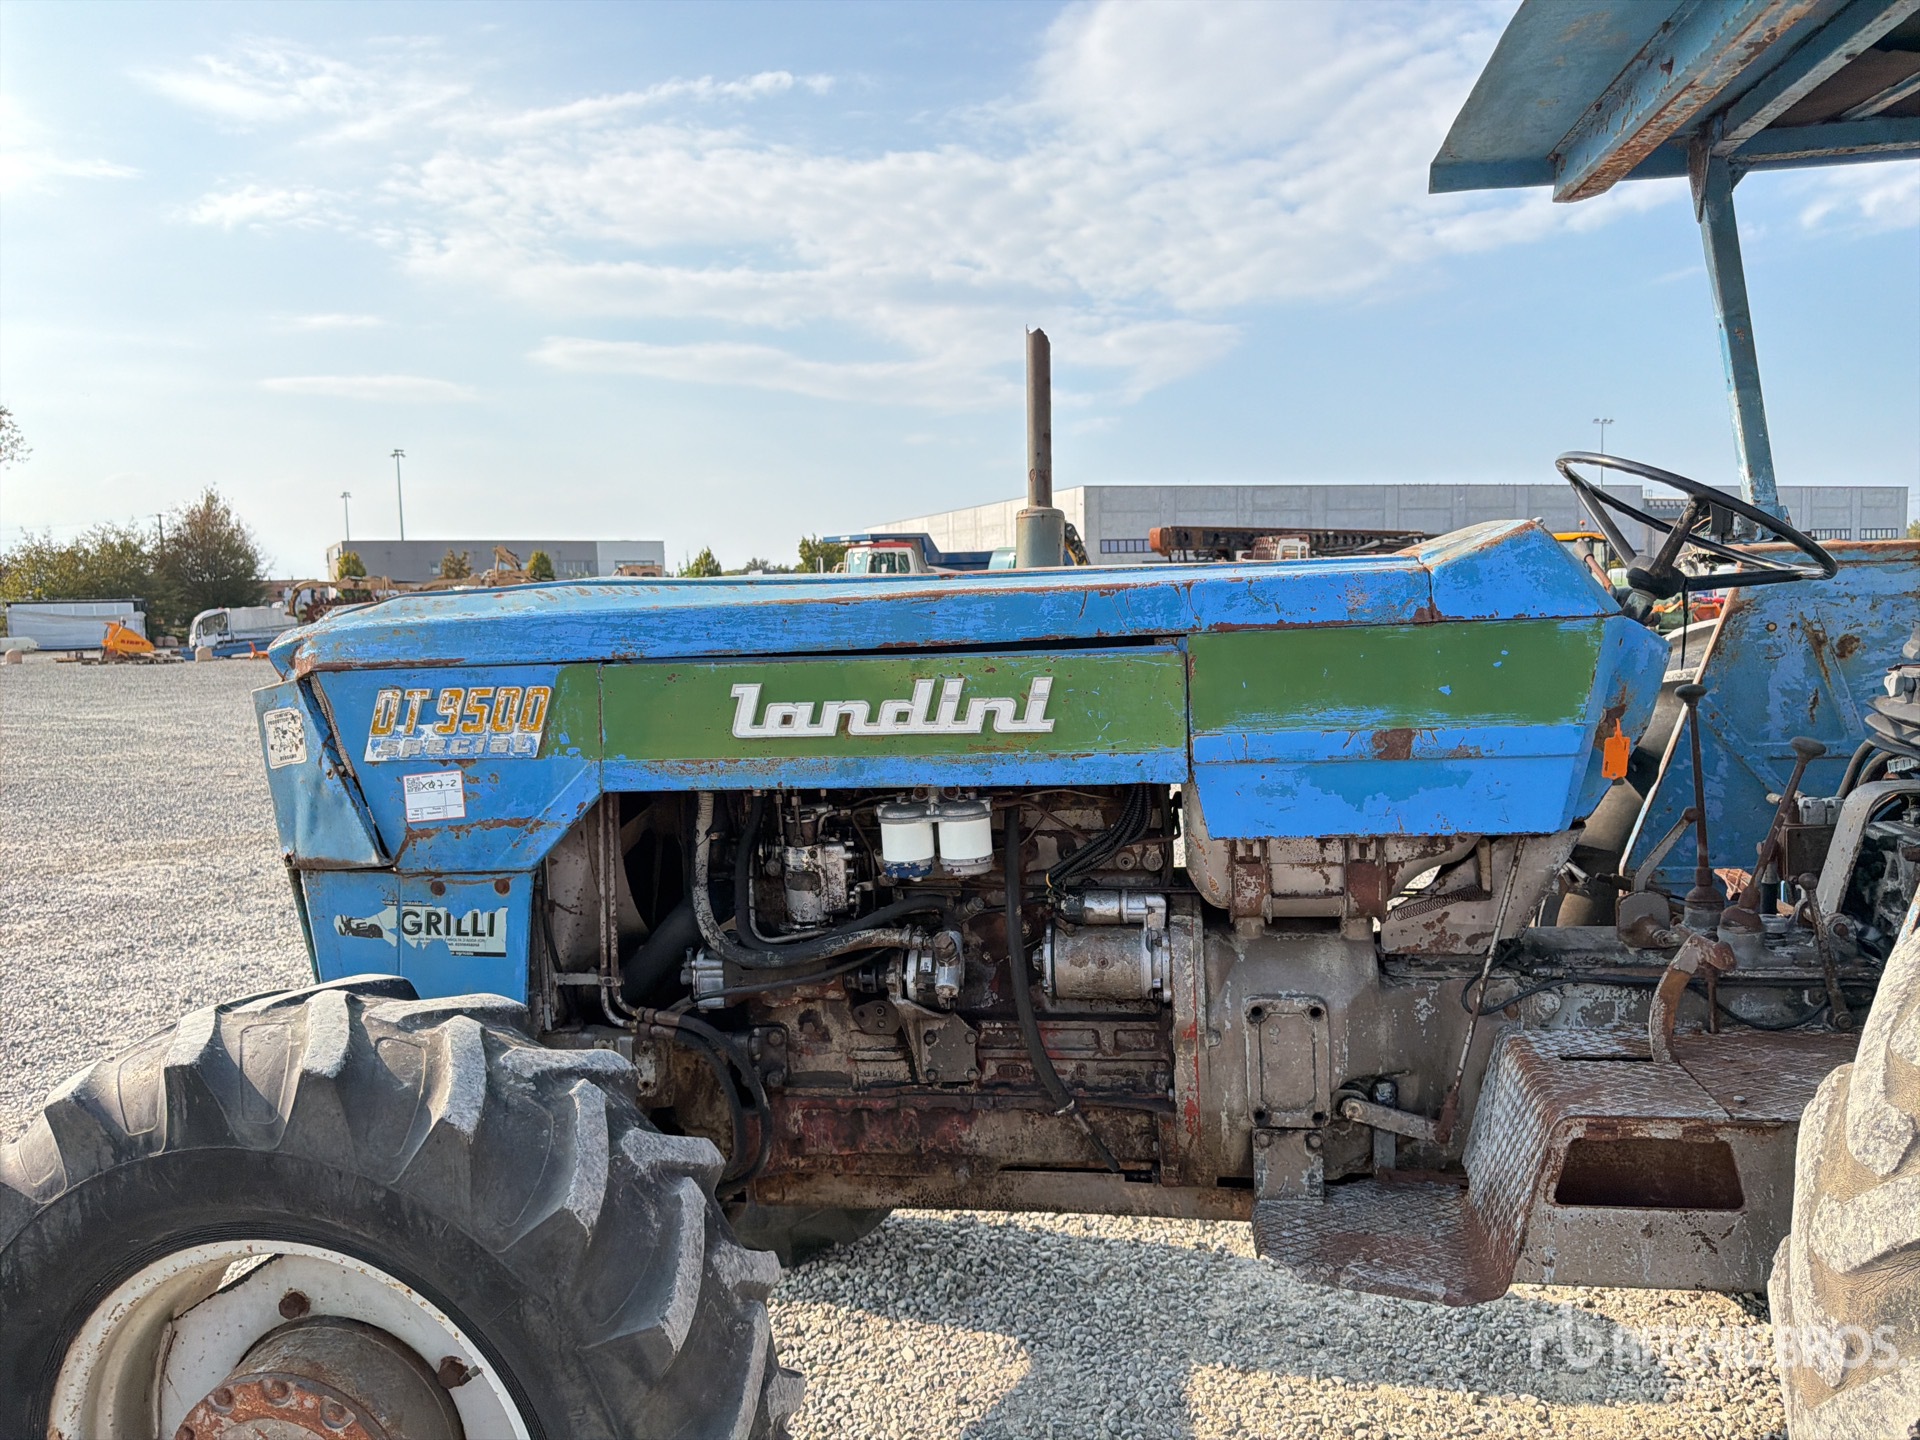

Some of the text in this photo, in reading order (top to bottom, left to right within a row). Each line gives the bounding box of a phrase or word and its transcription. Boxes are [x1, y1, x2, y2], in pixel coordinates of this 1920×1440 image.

[433, 686, 552, 735] 9500
[376, 735, 532, 758] special
[401, 909, 496, 937] GRILLI
